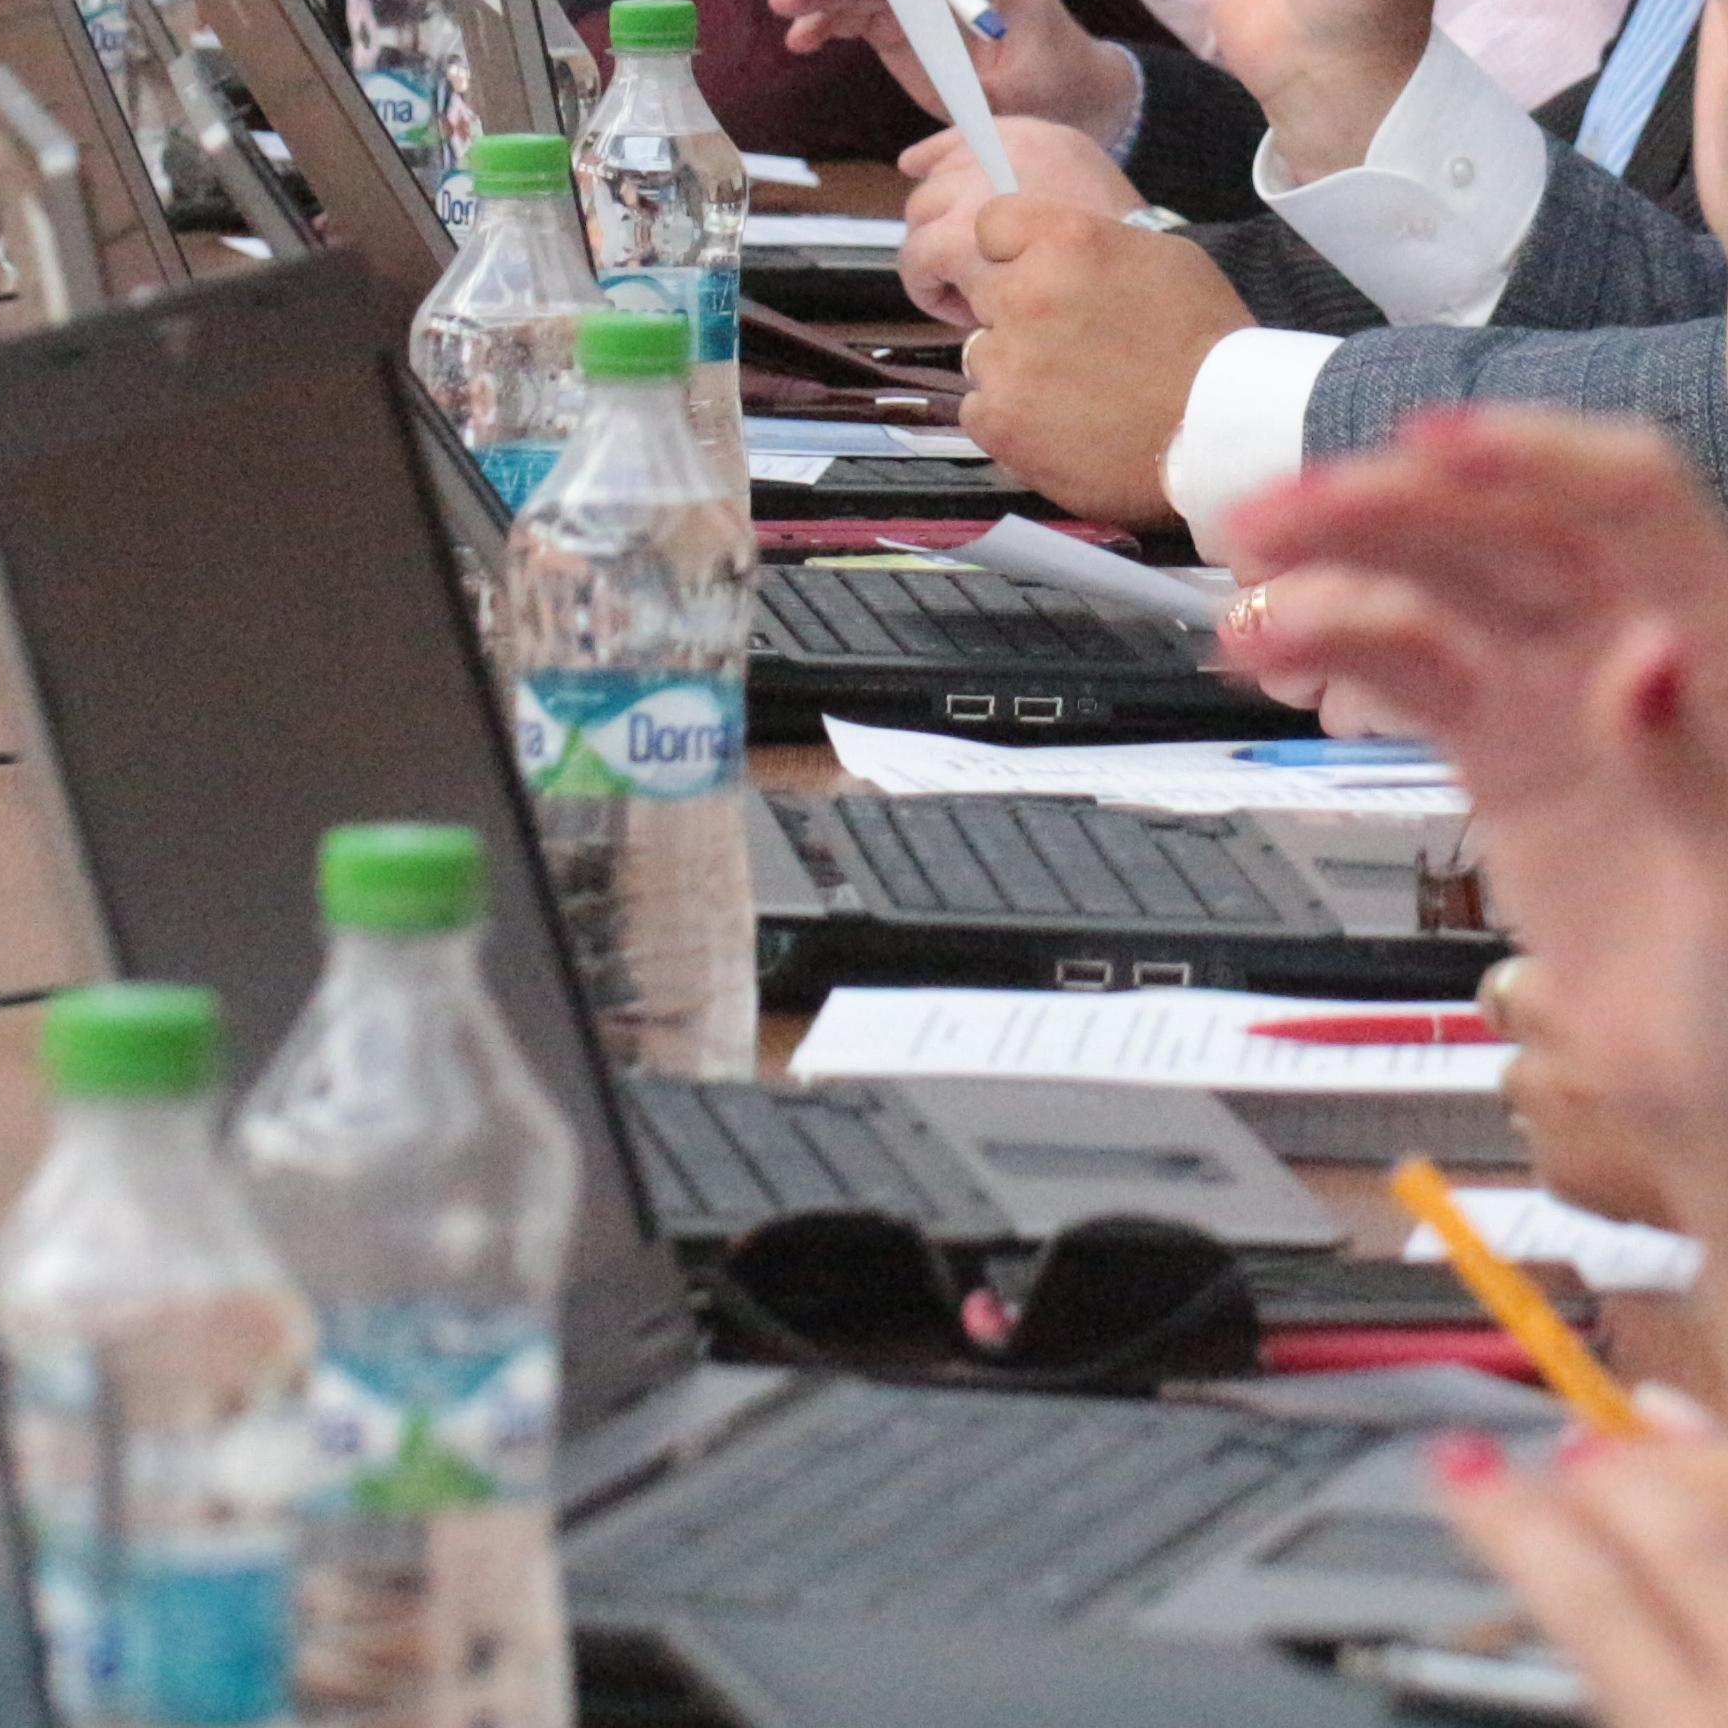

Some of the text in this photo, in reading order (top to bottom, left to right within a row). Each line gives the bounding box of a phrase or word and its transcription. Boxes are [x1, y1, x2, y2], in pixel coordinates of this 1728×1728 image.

[373, 98, 414, 123] rna
[441, 189, 480, 225] Dor
[628, 712, 731, 763] Dorna
